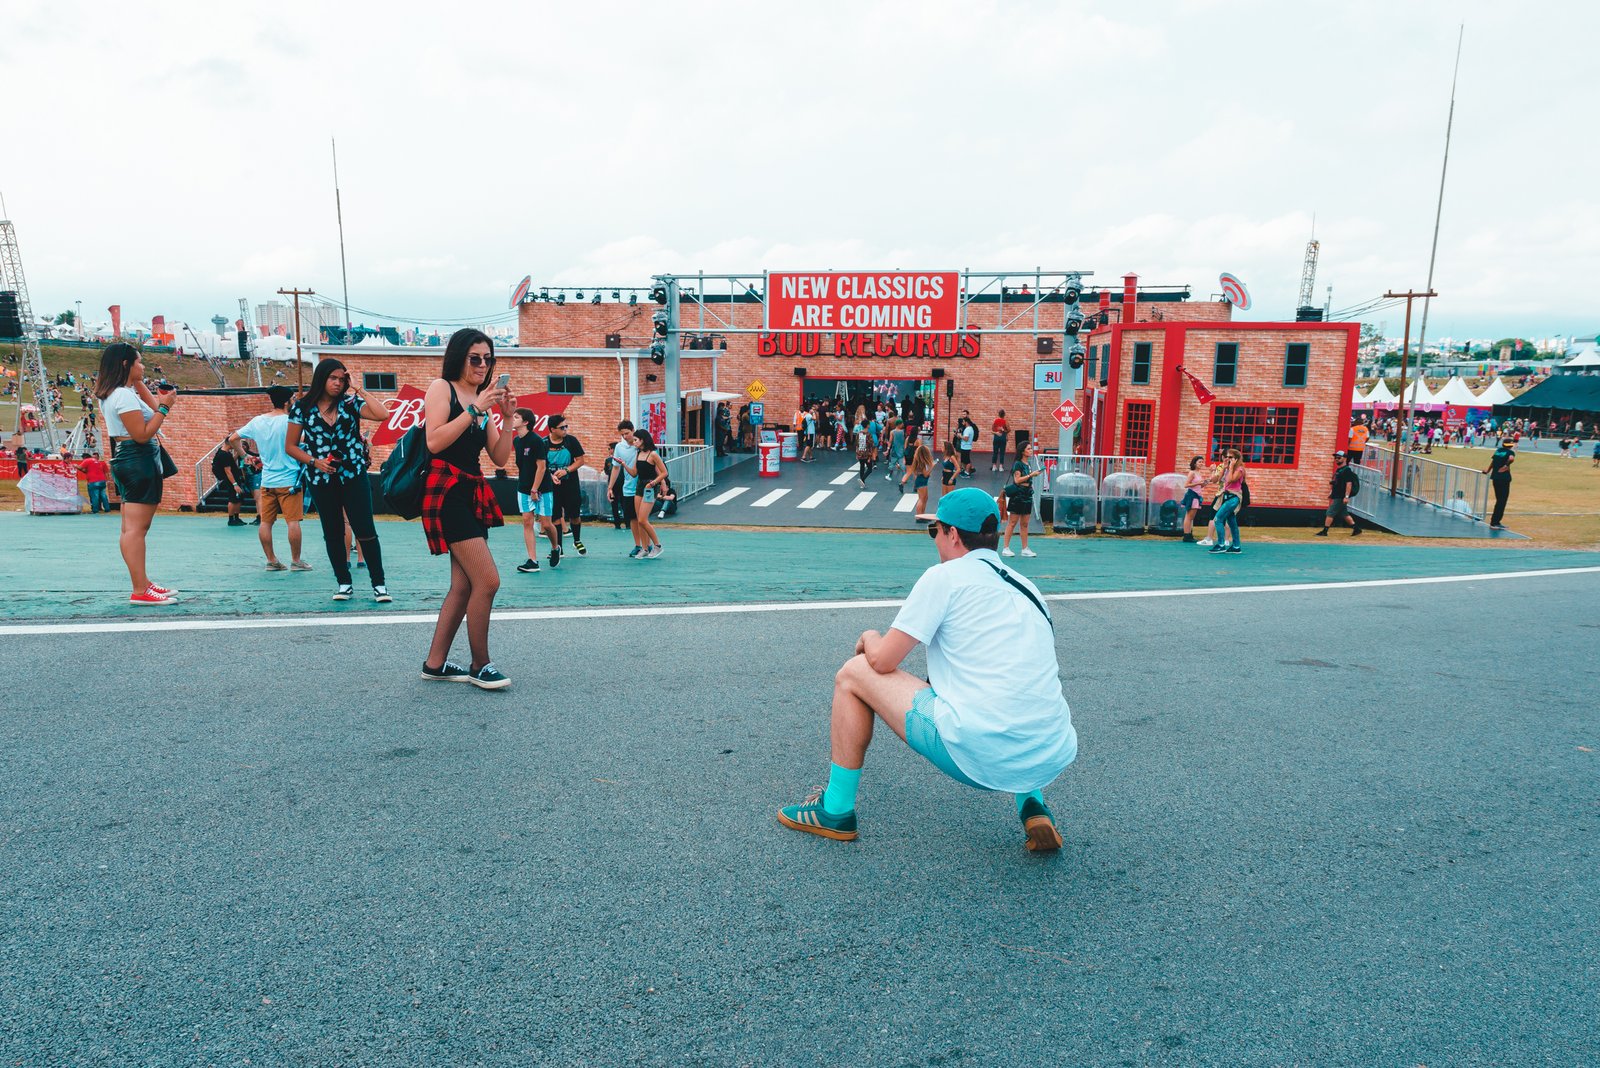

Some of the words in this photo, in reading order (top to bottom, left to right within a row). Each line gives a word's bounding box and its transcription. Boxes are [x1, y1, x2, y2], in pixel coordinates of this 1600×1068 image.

[782, 276, 830, 299] NEW
[836, 276, 944, 299] CLASSICS
[791, 304, 834, 328] ARE
[840, 304, 932, 328] COMING
[758, 327, 820, 357] BUD
[834, 326, 981, 358] RECORDS
